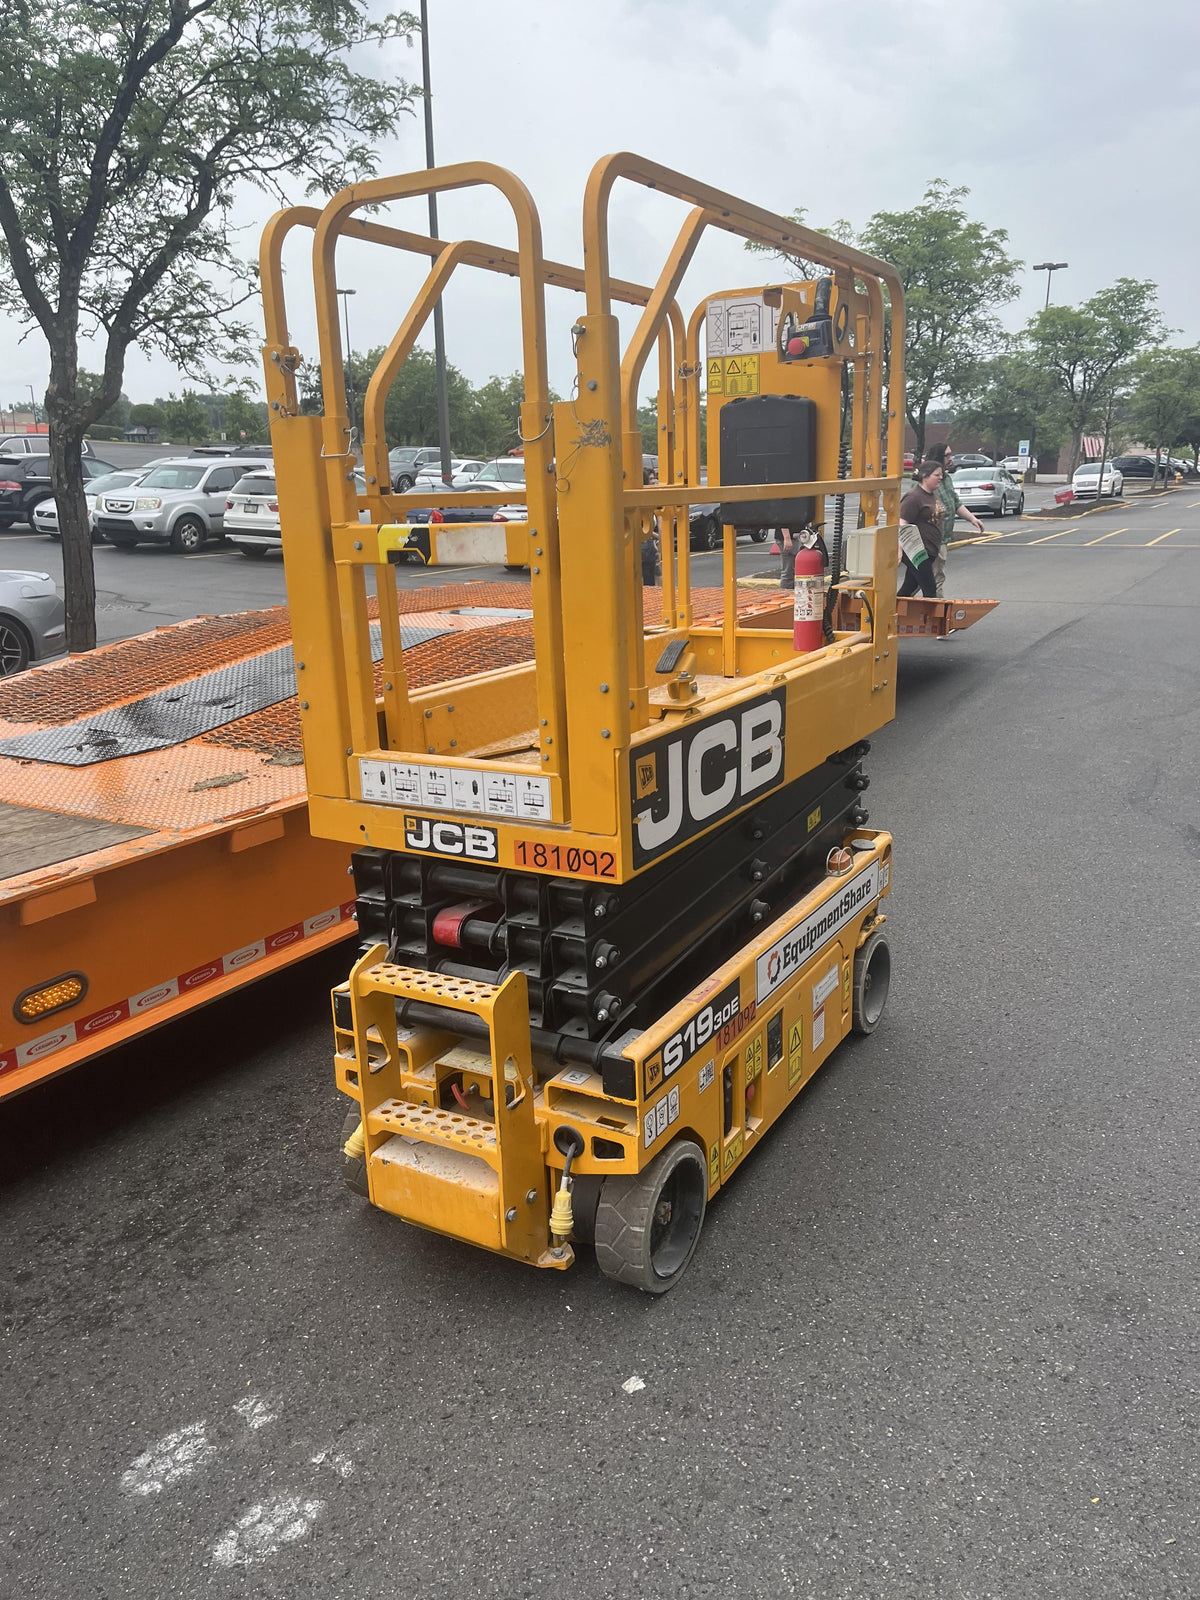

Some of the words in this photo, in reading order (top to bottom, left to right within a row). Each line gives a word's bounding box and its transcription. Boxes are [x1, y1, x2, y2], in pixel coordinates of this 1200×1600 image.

[638, 700, 781, 851] JCB
[407, 821, 496, 858] JCB
[518, 841, 615, 877] 181092
[783, 879, 871, 969] EquipmentShare
[717, 1001, 756, 1051] 181092
